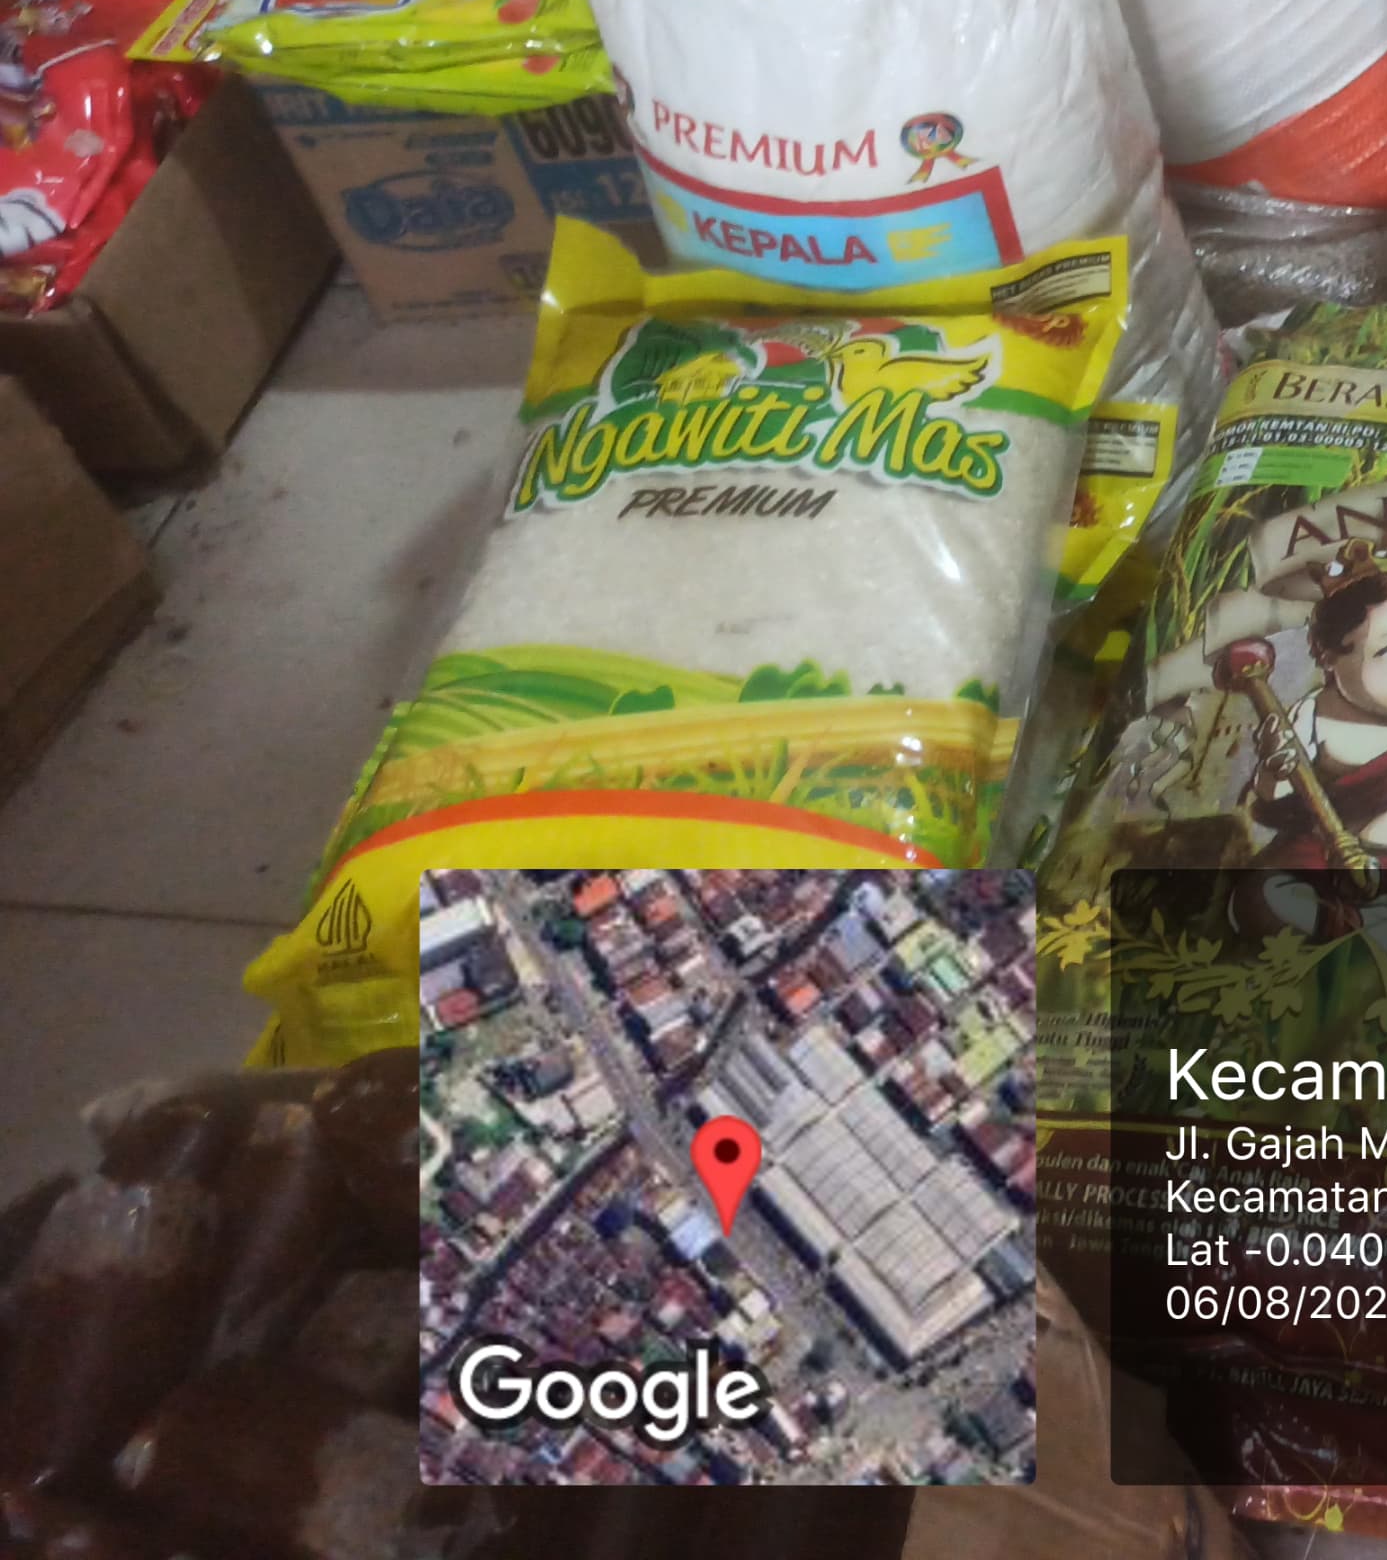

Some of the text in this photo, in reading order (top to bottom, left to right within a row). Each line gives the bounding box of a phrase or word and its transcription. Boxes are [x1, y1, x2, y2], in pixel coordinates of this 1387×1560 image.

[651, 99, 880, 177] PREMIUM
[692, 210, 878, 266] KEPALA
[517, 385, 1004, 513] Ngawiti Mas
[619, 483, 838, 520] PREMIUM
